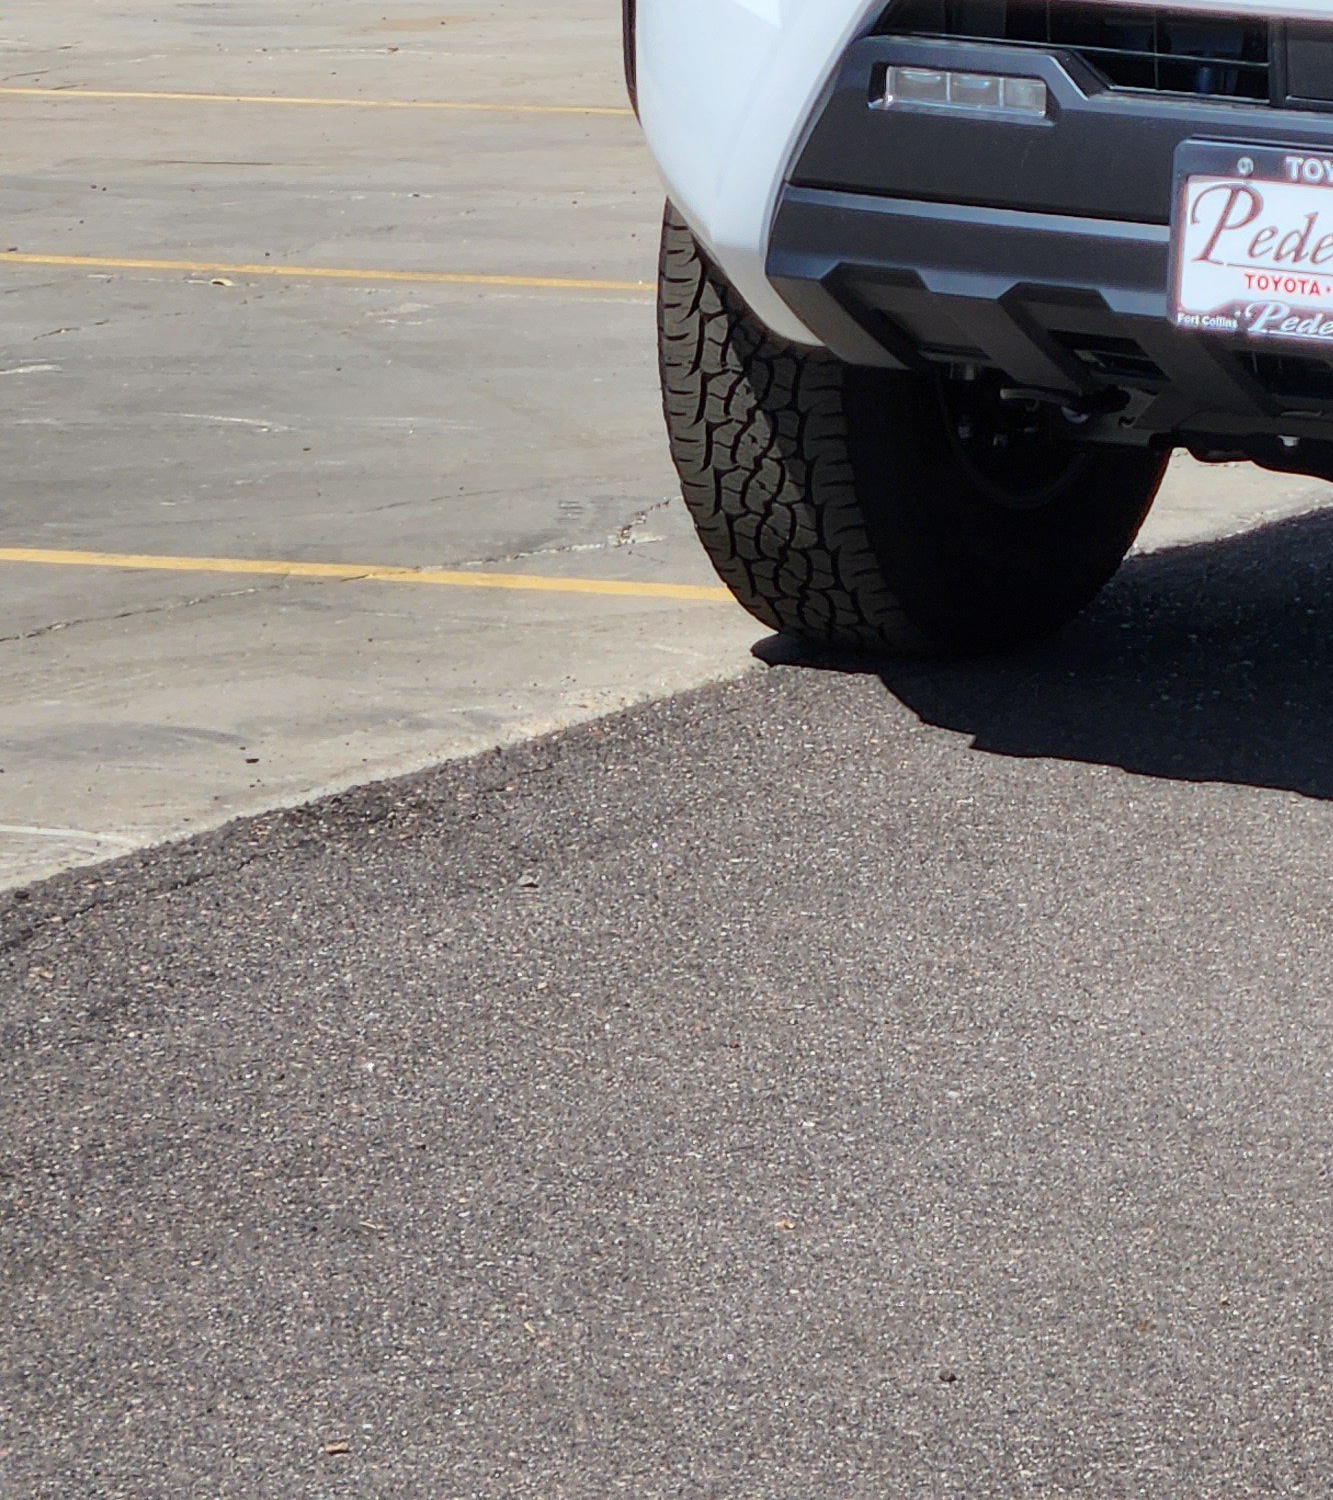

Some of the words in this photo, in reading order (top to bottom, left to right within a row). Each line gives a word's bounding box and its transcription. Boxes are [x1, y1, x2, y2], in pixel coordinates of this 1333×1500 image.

[1244, 273, 1321, 296] TOYOTA
[1177, 312, 1199, 325] Fort
[1201, 315, 1238, 330] Collins
